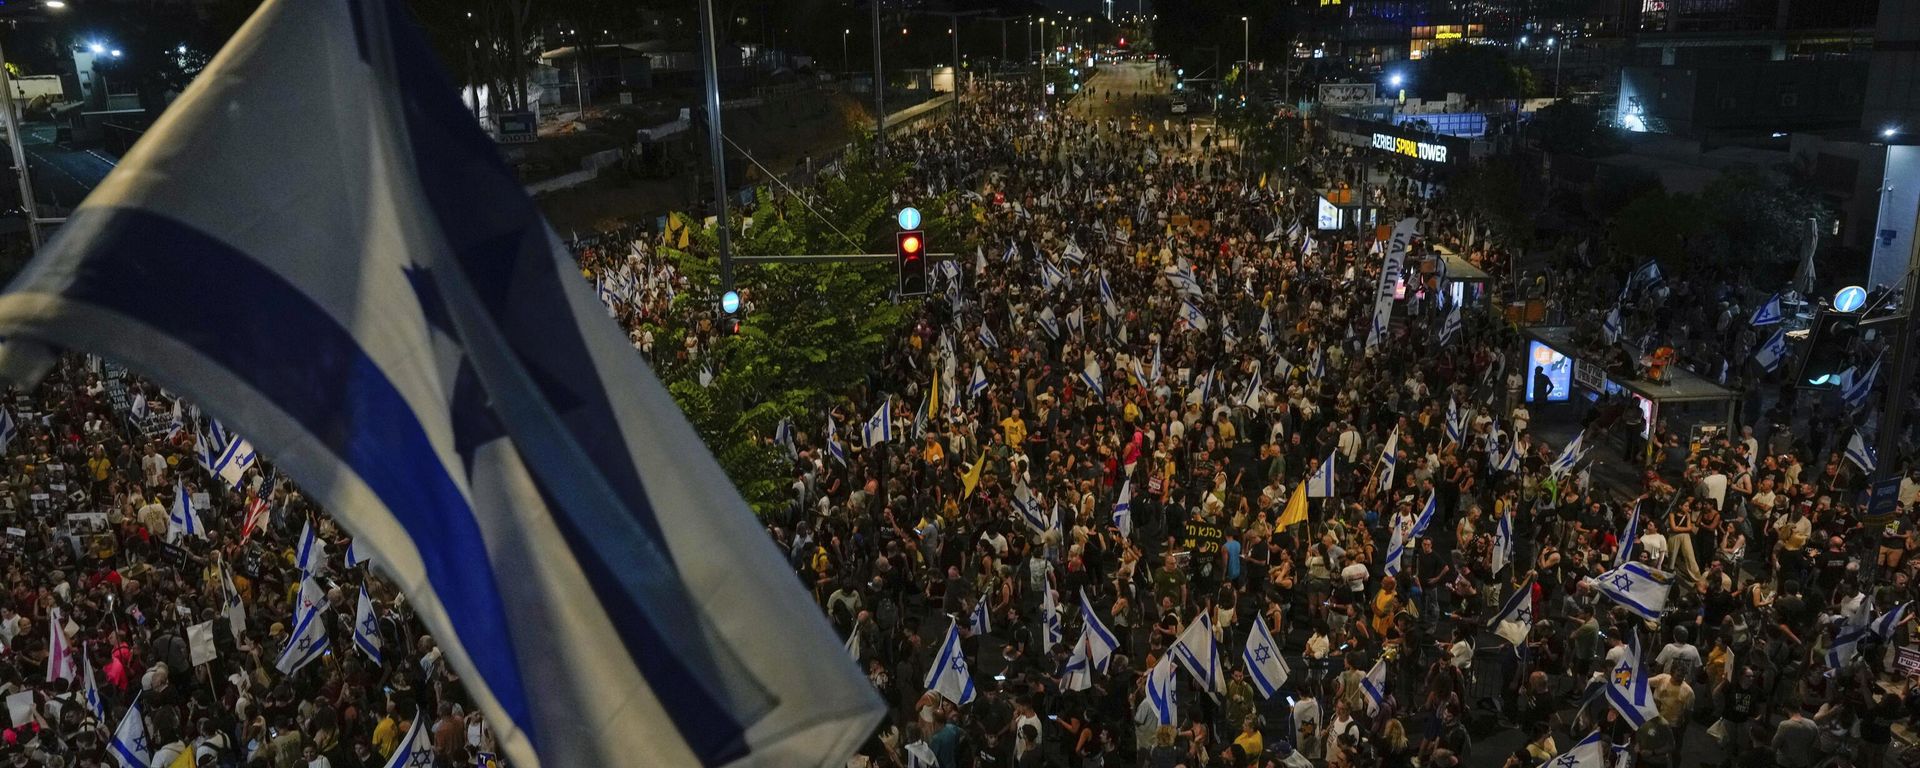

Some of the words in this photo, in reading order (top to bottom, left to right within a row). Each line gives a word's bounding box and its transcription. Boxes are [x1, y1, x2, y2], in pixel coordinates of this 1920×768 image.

[1372, 133, 1395, 152] AZRIELI
[1396, 138, 1418, 158] SPIRAL
[1418, 142, 1446, 162] TOWER
[1381, 258, 1400, 302] עתיד
[1186, 525, 1196, 536] חי
[1198, 527, 1222, 538] כהנא
